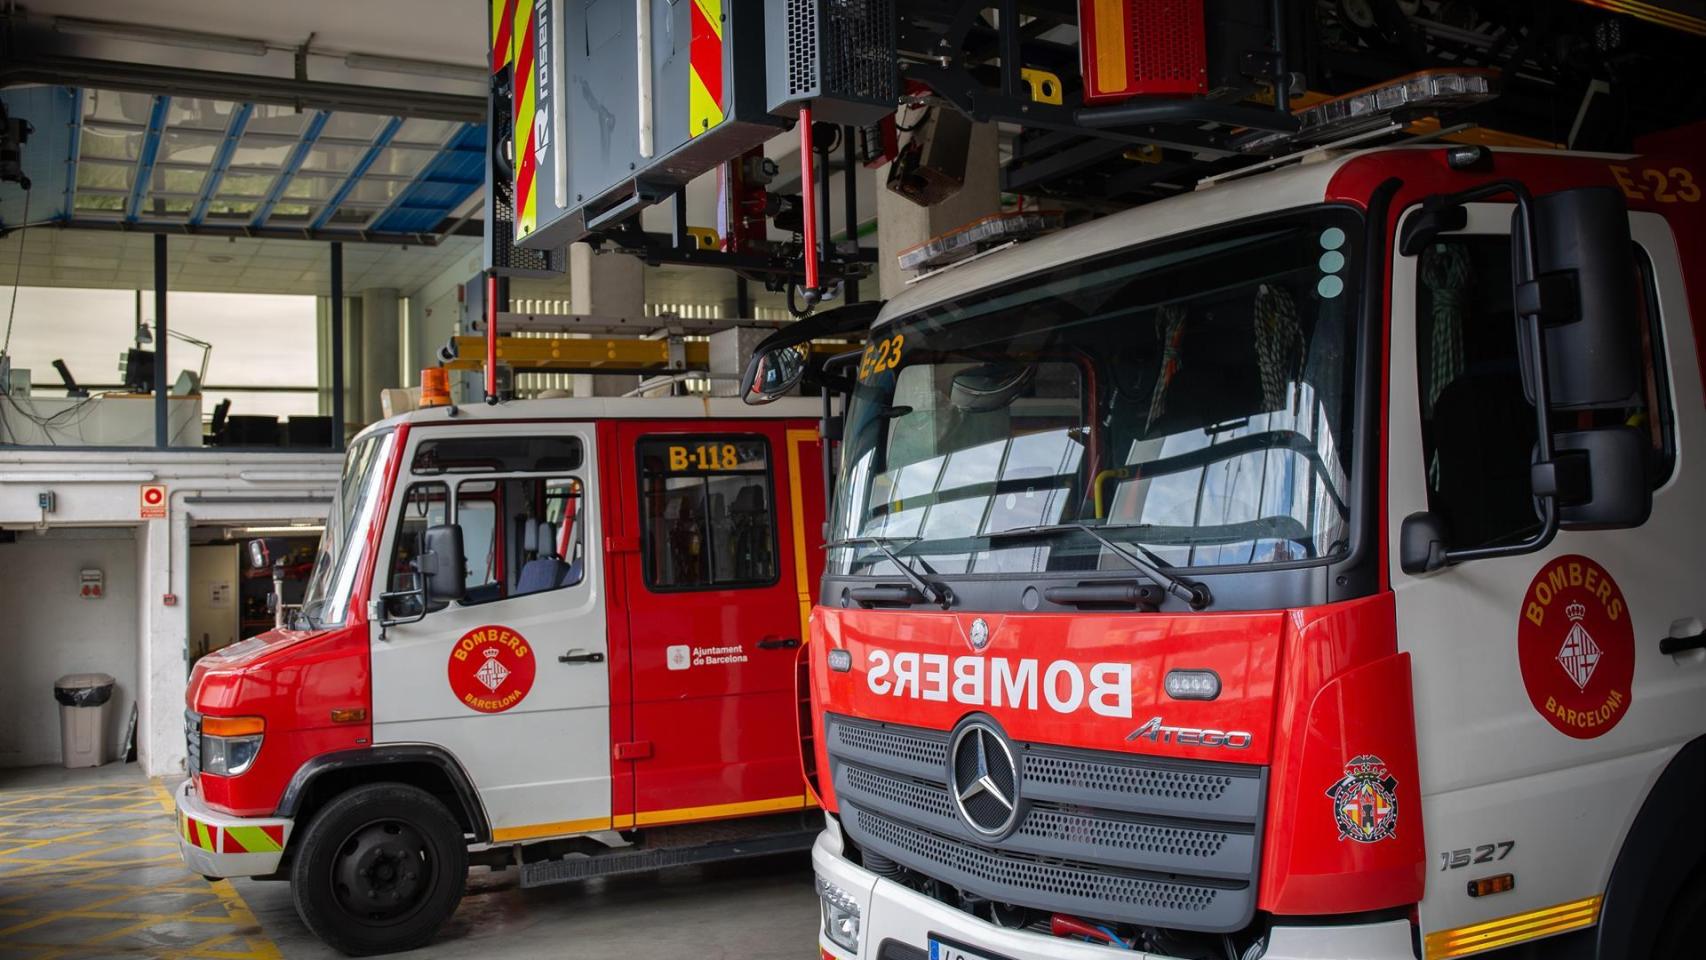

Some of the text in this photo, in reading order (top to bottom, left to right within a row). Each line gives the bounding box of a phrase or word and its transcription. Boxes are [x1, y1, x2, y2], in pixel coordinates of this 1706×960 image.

[1608, 165, 1701, 203] E-23
[860, 334, 904, 380] E-23
[669, 444, 738, 471] B-118
[1525, 562, 1622, 627] BOMBERS
[454, 629, 528, 661] BOMBERS
[692, 645, 743, 658] Ajuntament
[693, 654, 748, 666] de Barcelona
[464, 689, 522, 709] BARCELONA
[1545, 689, 1623, 728] BARCELONA
[1440, 840, 1515, 871] 1527
